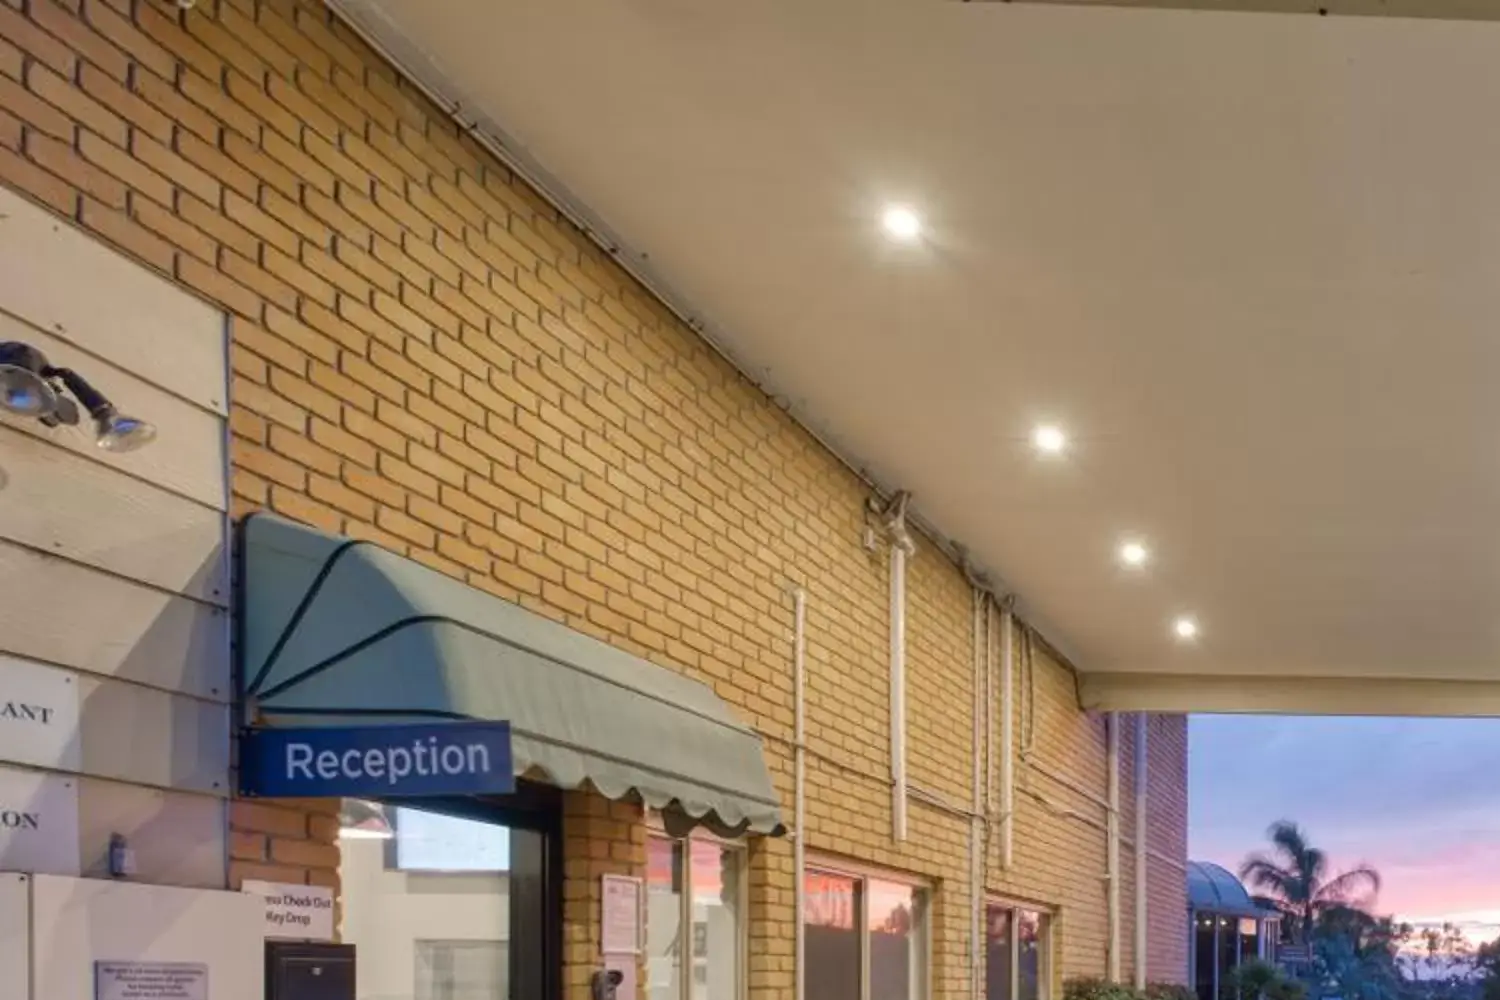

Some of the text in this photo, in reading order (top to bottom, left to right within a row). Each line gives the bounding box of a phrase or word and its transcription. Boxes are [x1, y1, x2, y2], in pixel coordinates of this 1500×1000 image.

[286, 736, 491, 785] Reception
[1, 810, 40, 831] ON
[283, 894, 312, 908] Check
[313, 896, 332, 909] Out
[285, 910, 311, 927] Drop
